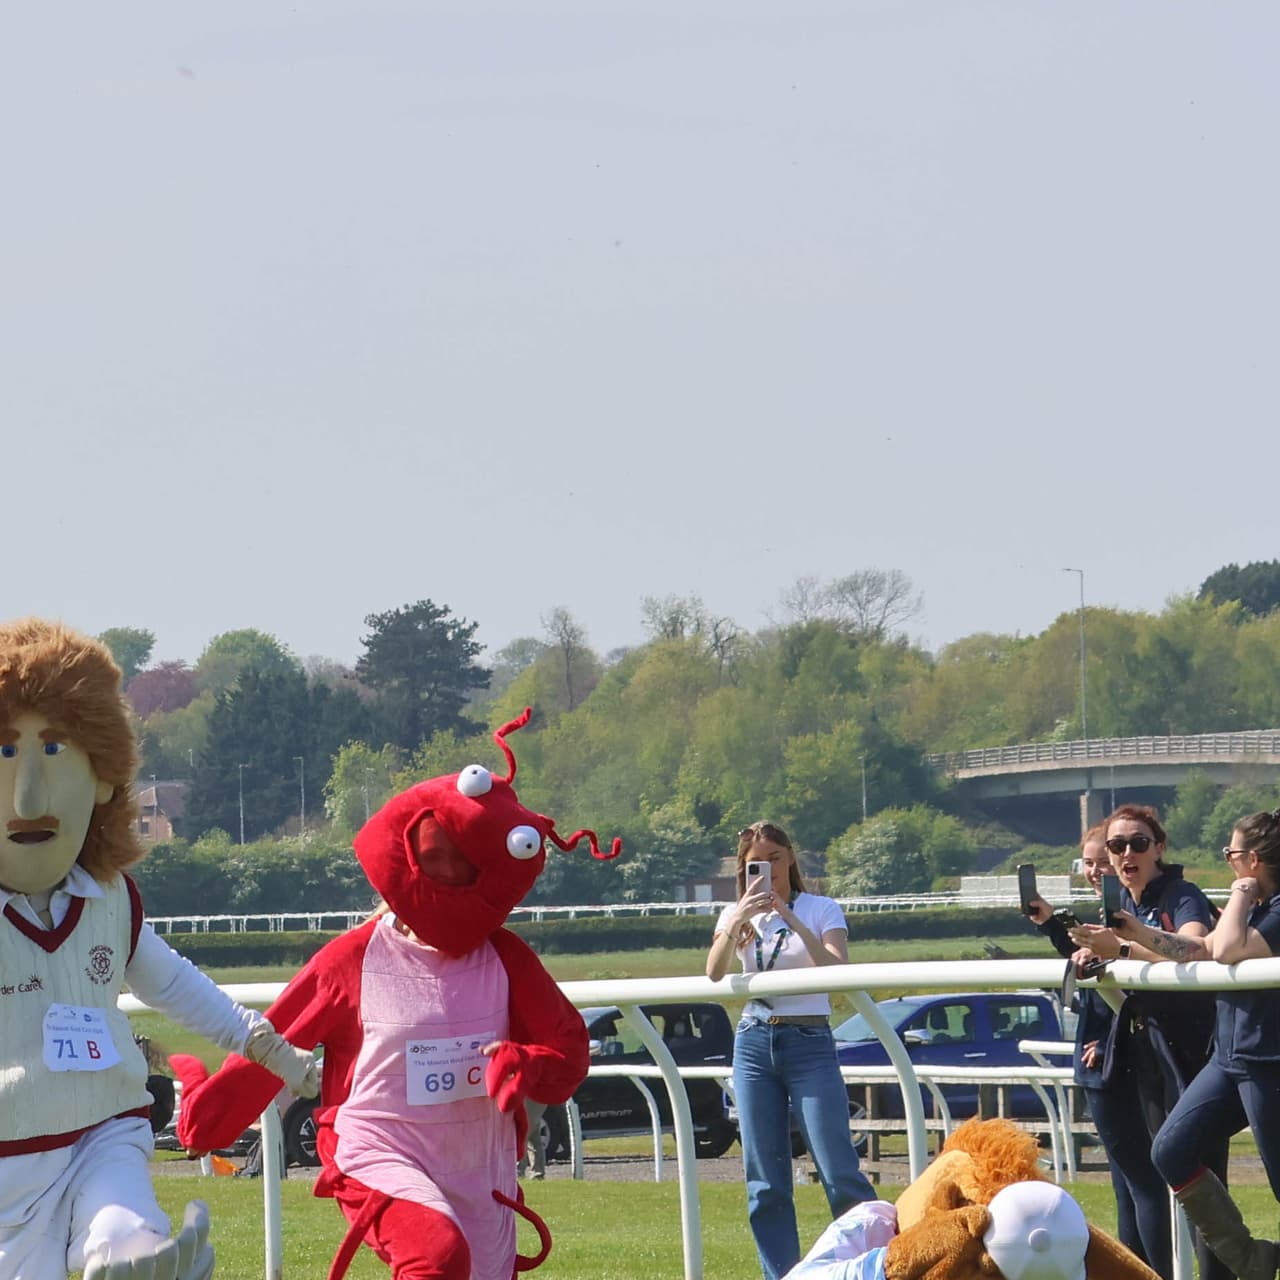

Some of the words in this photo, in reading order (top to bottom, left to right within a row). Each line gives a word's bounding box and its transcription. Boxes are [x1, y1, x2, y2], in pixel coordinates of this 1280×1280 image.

[53, 1039, 78, 1059] 71
[87, 1040, 101, 1060] B
[425, 1072, 455, 1092] 69
[467, 1066, 481, 1085] C
